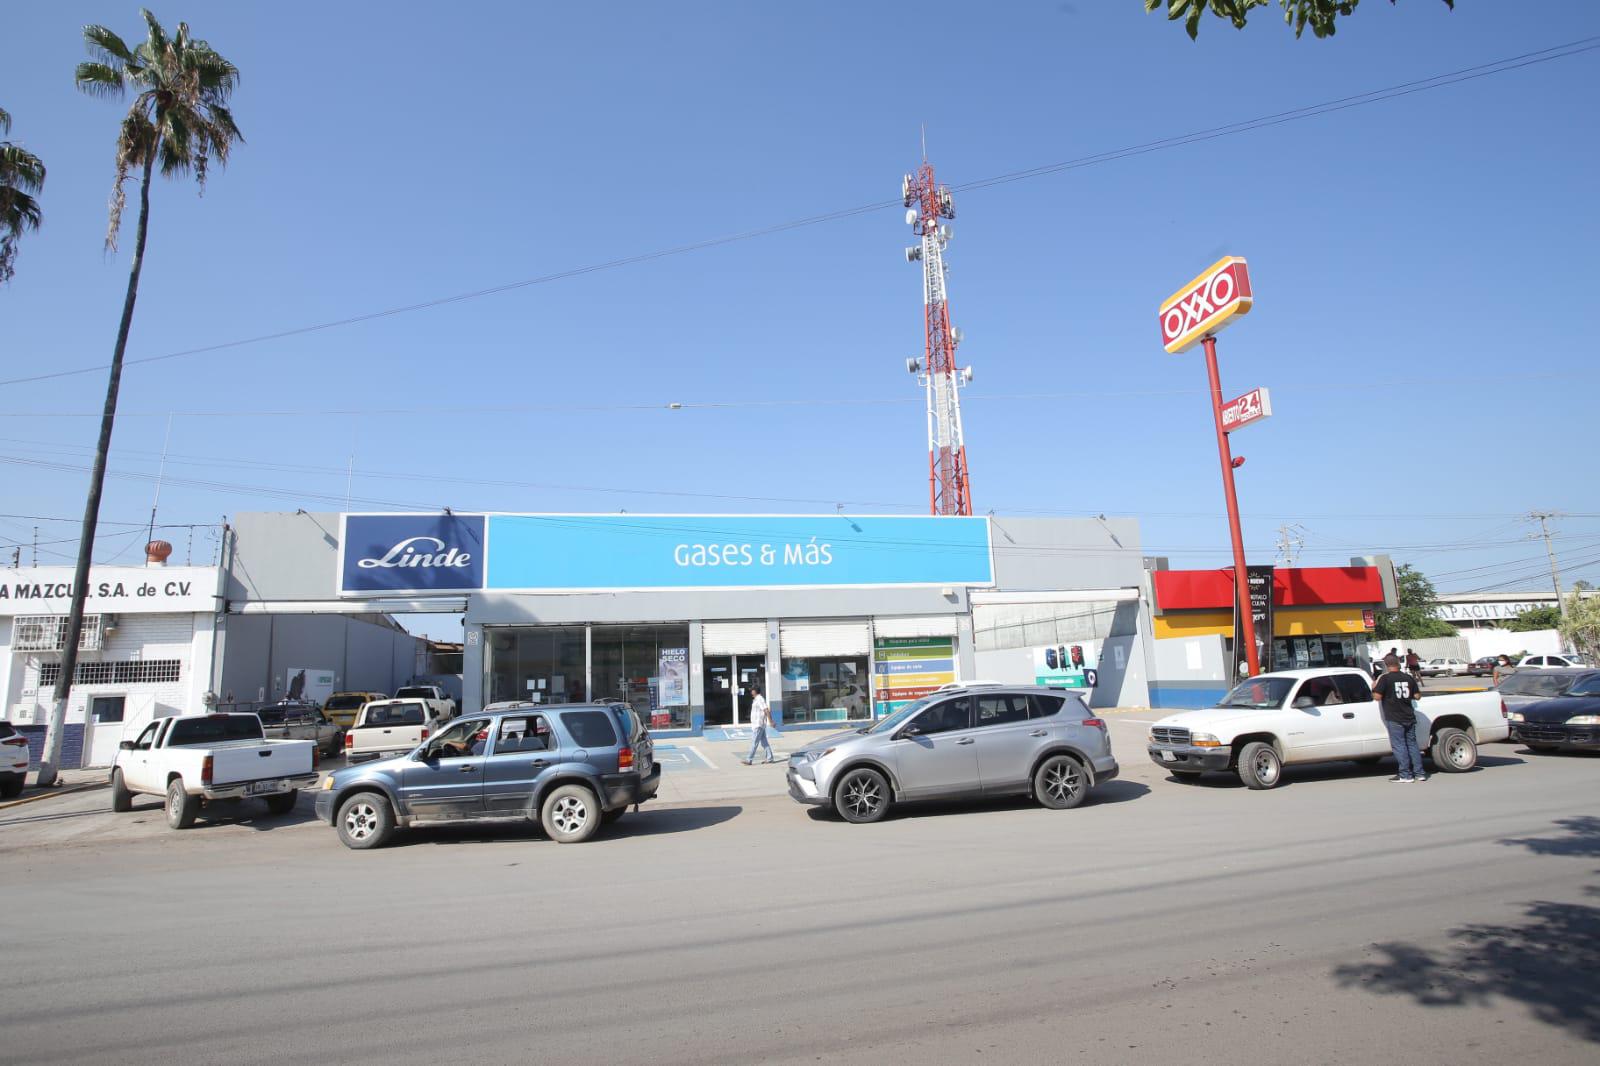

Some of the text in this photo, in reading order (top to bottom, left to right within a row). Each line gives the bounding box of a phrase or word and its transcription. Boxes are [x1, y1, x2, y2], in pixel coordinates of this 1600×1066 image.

[1164, 271, 1233, 338] OXXO
[1239, 392, 1260, 414] 24
[358, 536, 471, 568] Linde
[674, 535, 833, 566] Gases & Más
[98, 582, 129, 598] S.A.
[136, 582, 157, 597] de
[164, 581, 192, 597] C.V.
[1394, 681, 1410, 699] 55
